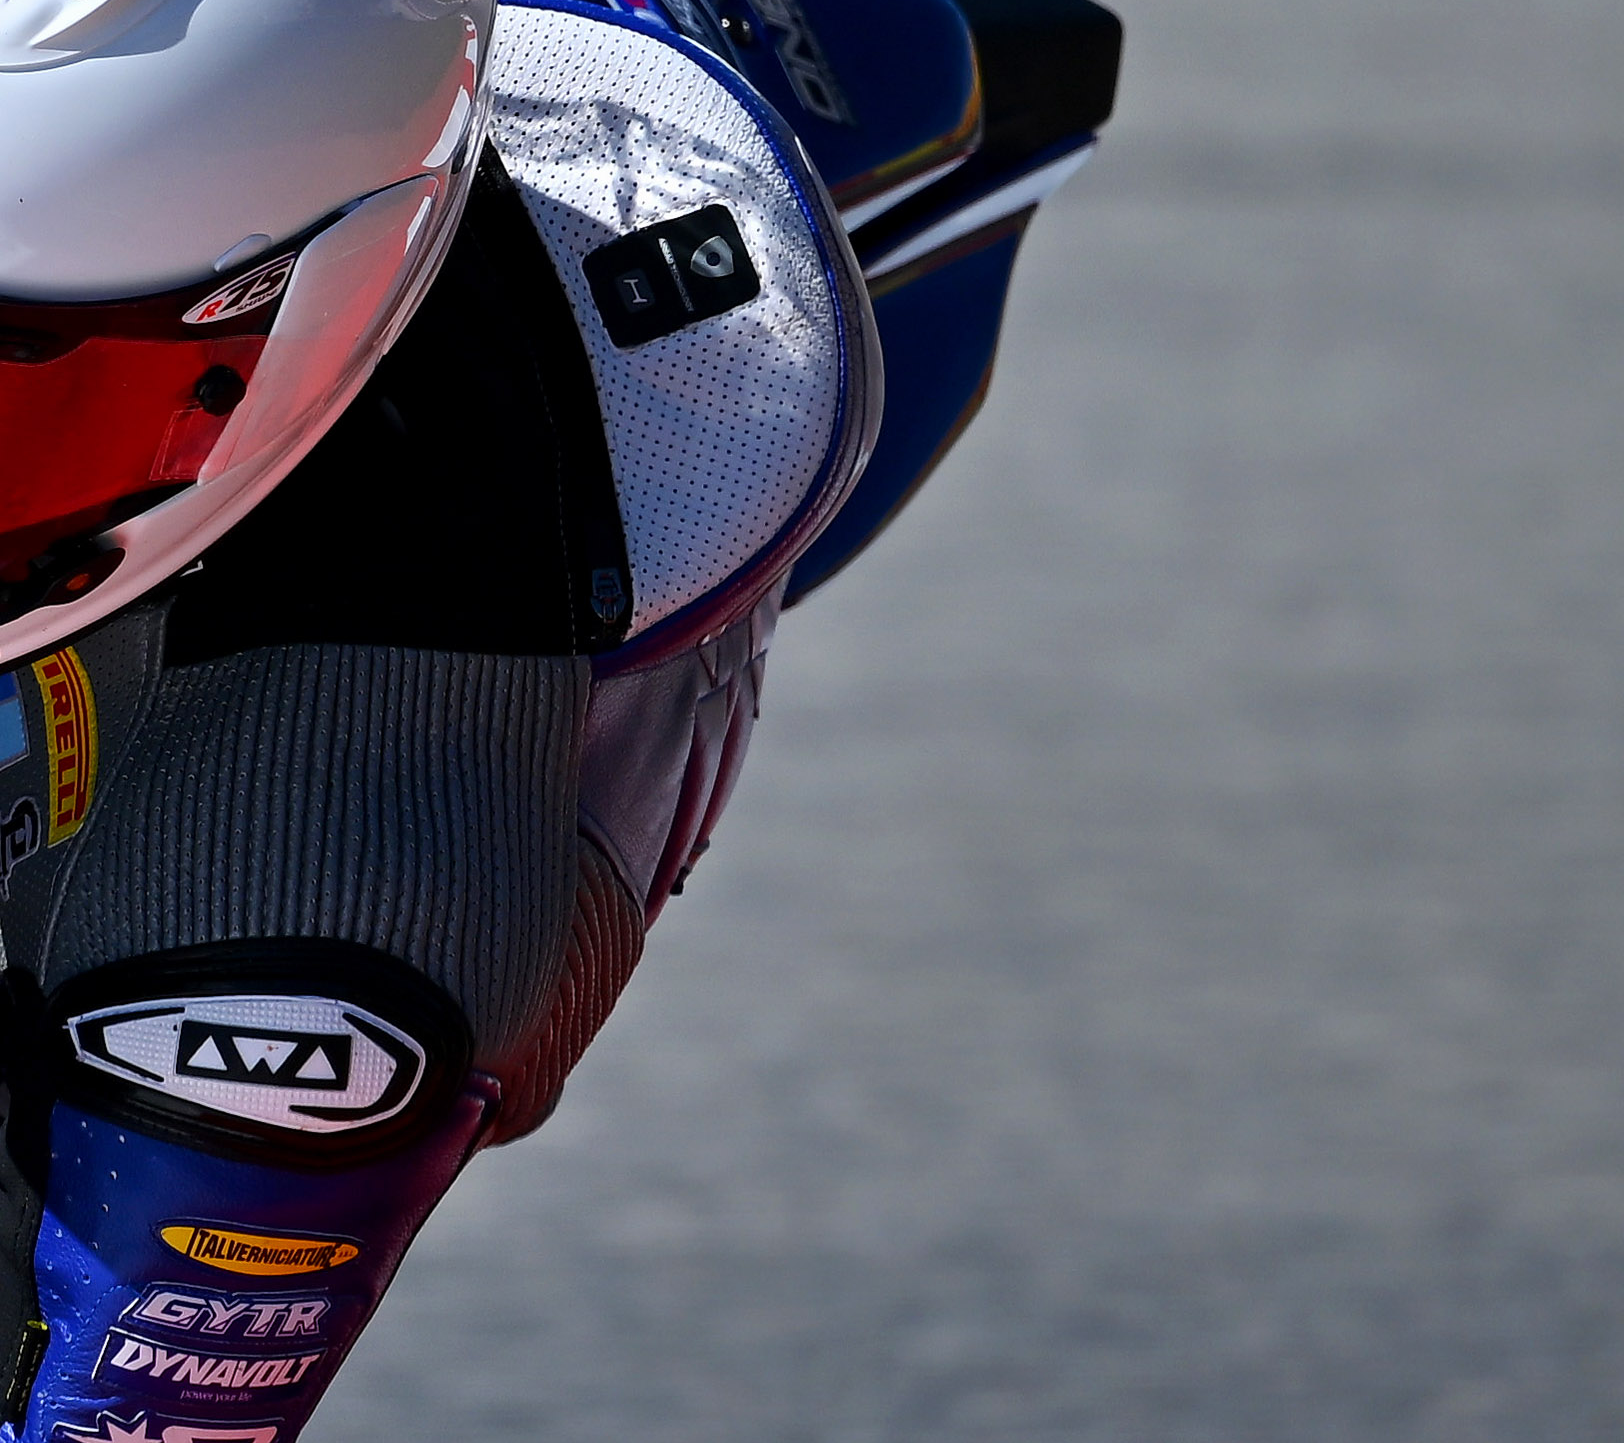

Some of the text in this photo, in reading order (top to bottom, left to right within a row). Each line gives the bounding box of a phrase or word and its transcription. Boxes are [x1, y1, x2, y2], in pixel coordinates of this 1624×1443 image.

[42, 648, 87, 827] IRELLI
[138, 1291, 328, 1336] GYTR
[110, 1339, 320, 1388] DYNAVOLT
